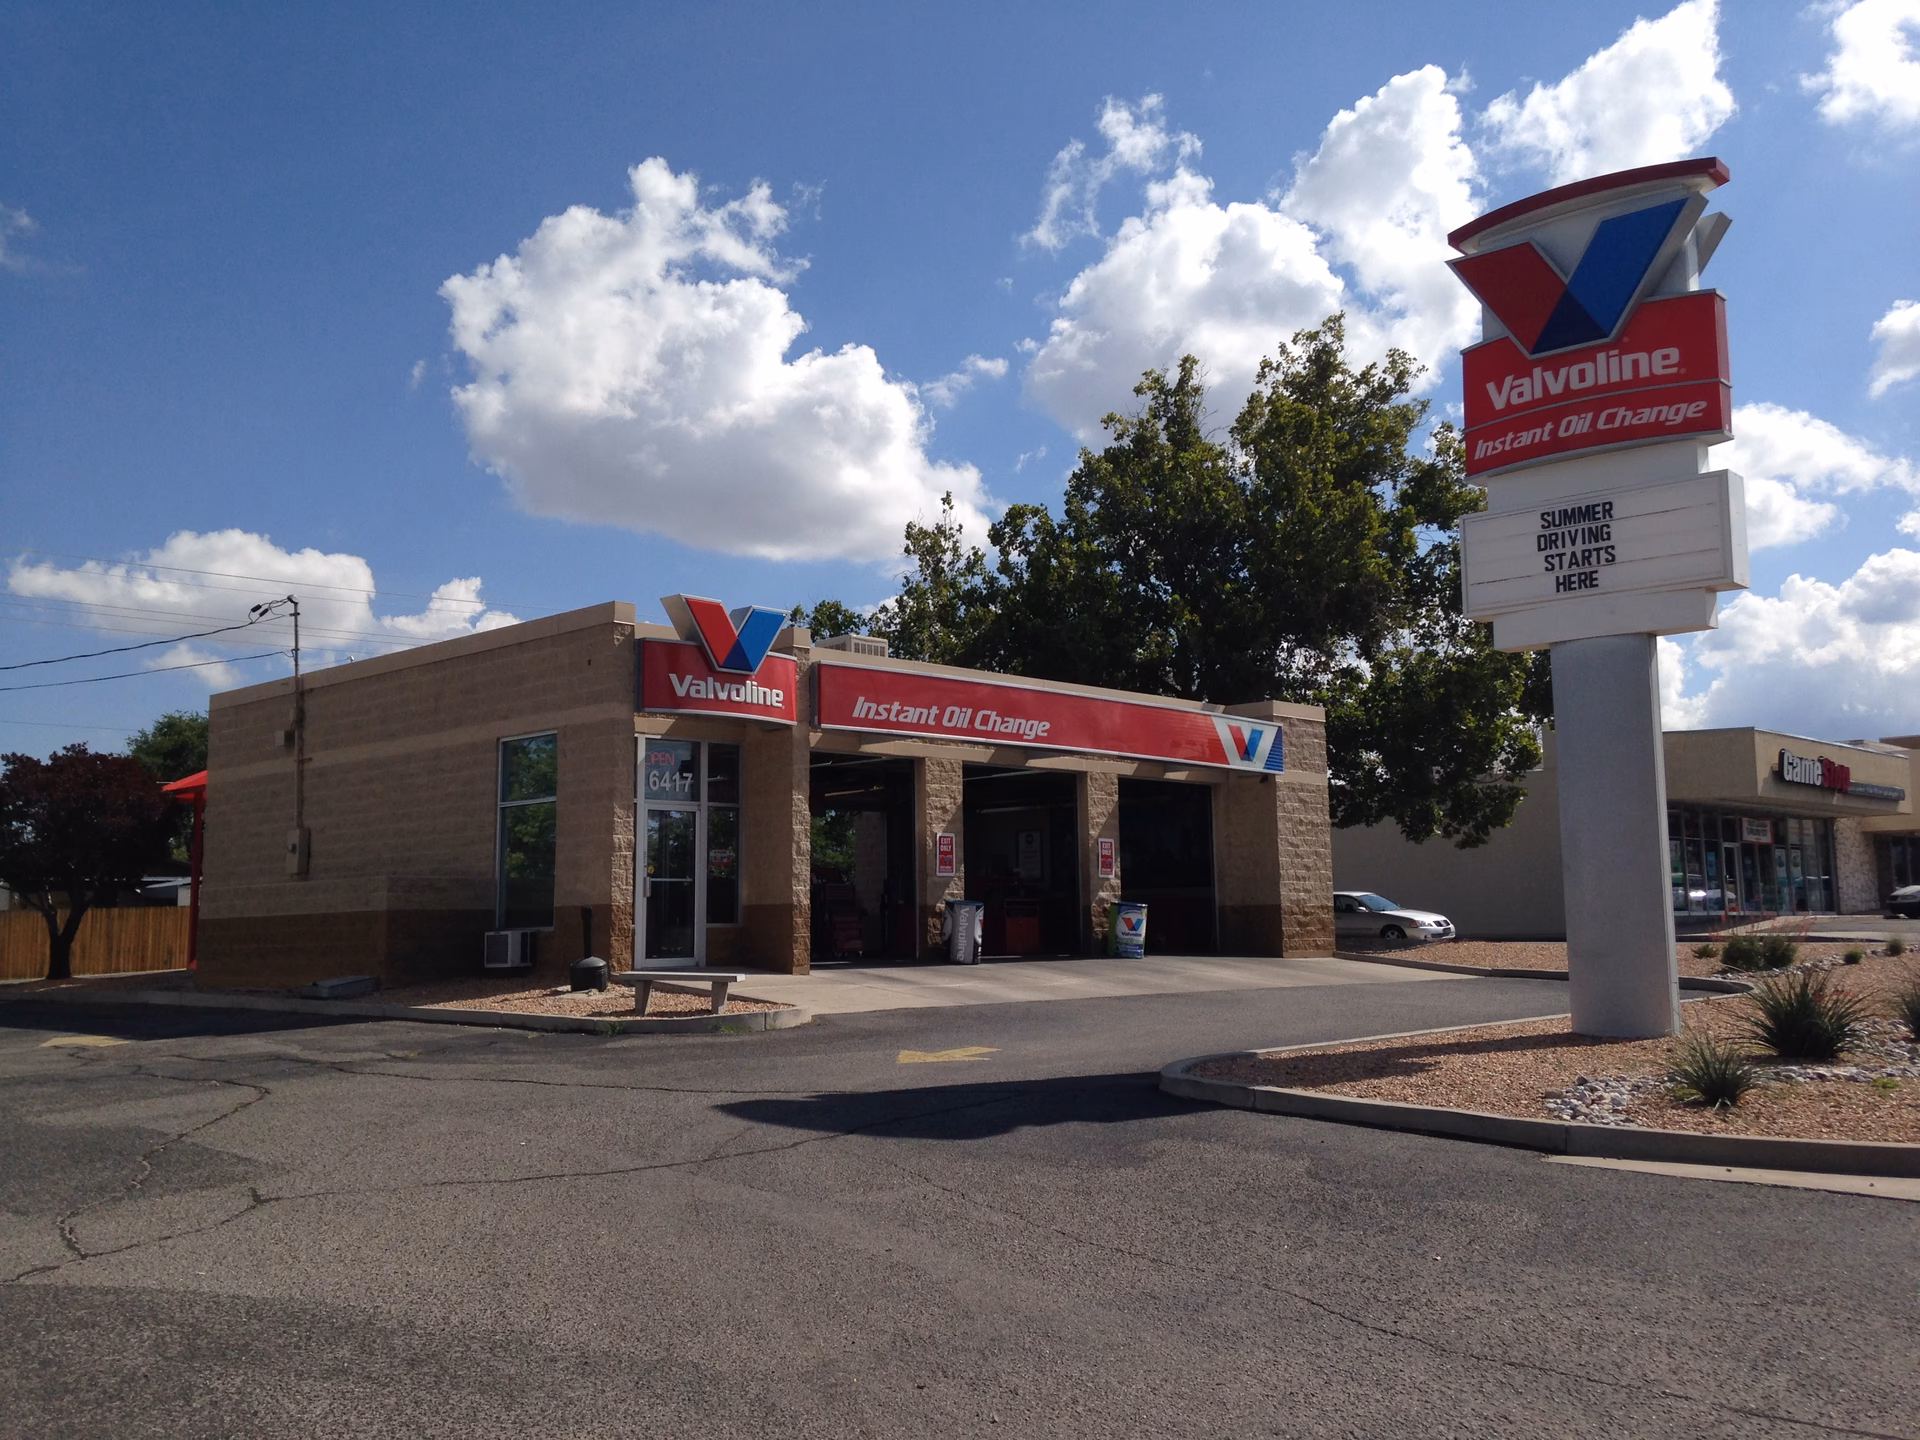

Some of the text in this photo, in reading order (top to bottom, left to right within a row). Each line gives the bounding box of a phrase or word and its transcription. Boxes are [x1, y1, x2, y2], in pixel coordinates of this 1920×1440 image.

[1486, 347, 1680, 411] Valvoline
[1474, 400, 1708, 460] Instant Oil Change
[1540, 501, 1613, 529] SUMMER
[1537, 524, 1611, 552] DRIVING
[1544, 545, 1616, 572] STARTS
[1555, 570, 1599, 593] HERE
[668, 673, 784, 708] Valvoline
[852, 696, 1051, 740] Instant Oil Change
[644, 752, 675, 767] OPEN
[650, 770, 693, 793] 6417
[957, 907, 970, 961] Valvoline
